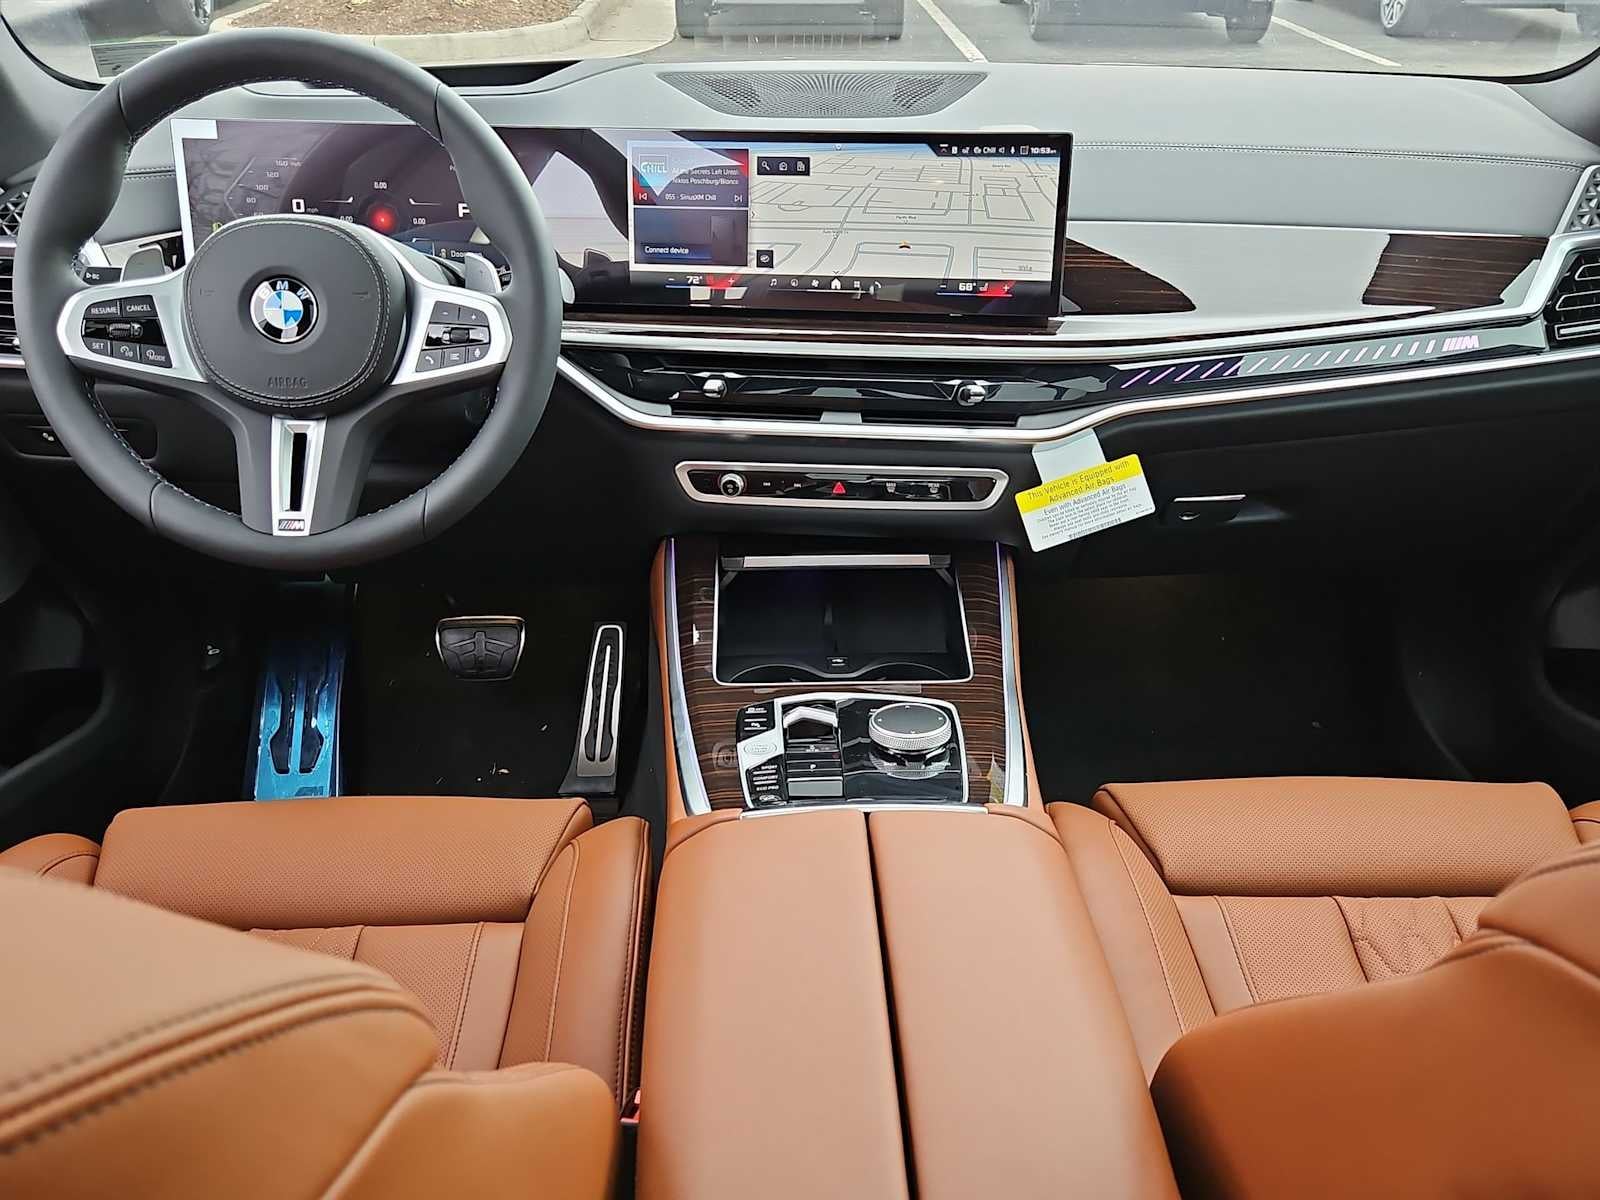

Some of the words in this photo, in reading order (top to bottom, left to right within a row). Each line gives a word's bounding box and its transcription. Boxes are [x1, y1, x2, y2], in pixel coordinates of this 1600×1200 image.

[644, 246, 669, 254] Connect
[90, 306, 118, 314] RESUME
[1028, 489, 1043, 500] This
[1044, 481, 1070, 494] Vehicle
[1080, 466, 1113, 482] Equipped
[1114, 460, 1130, 471] with
[1050, 486, 1083, 503] Advanced
[1085, 482, 1095, 491] Air
[1072, 490, 1101, 506] Advanced
